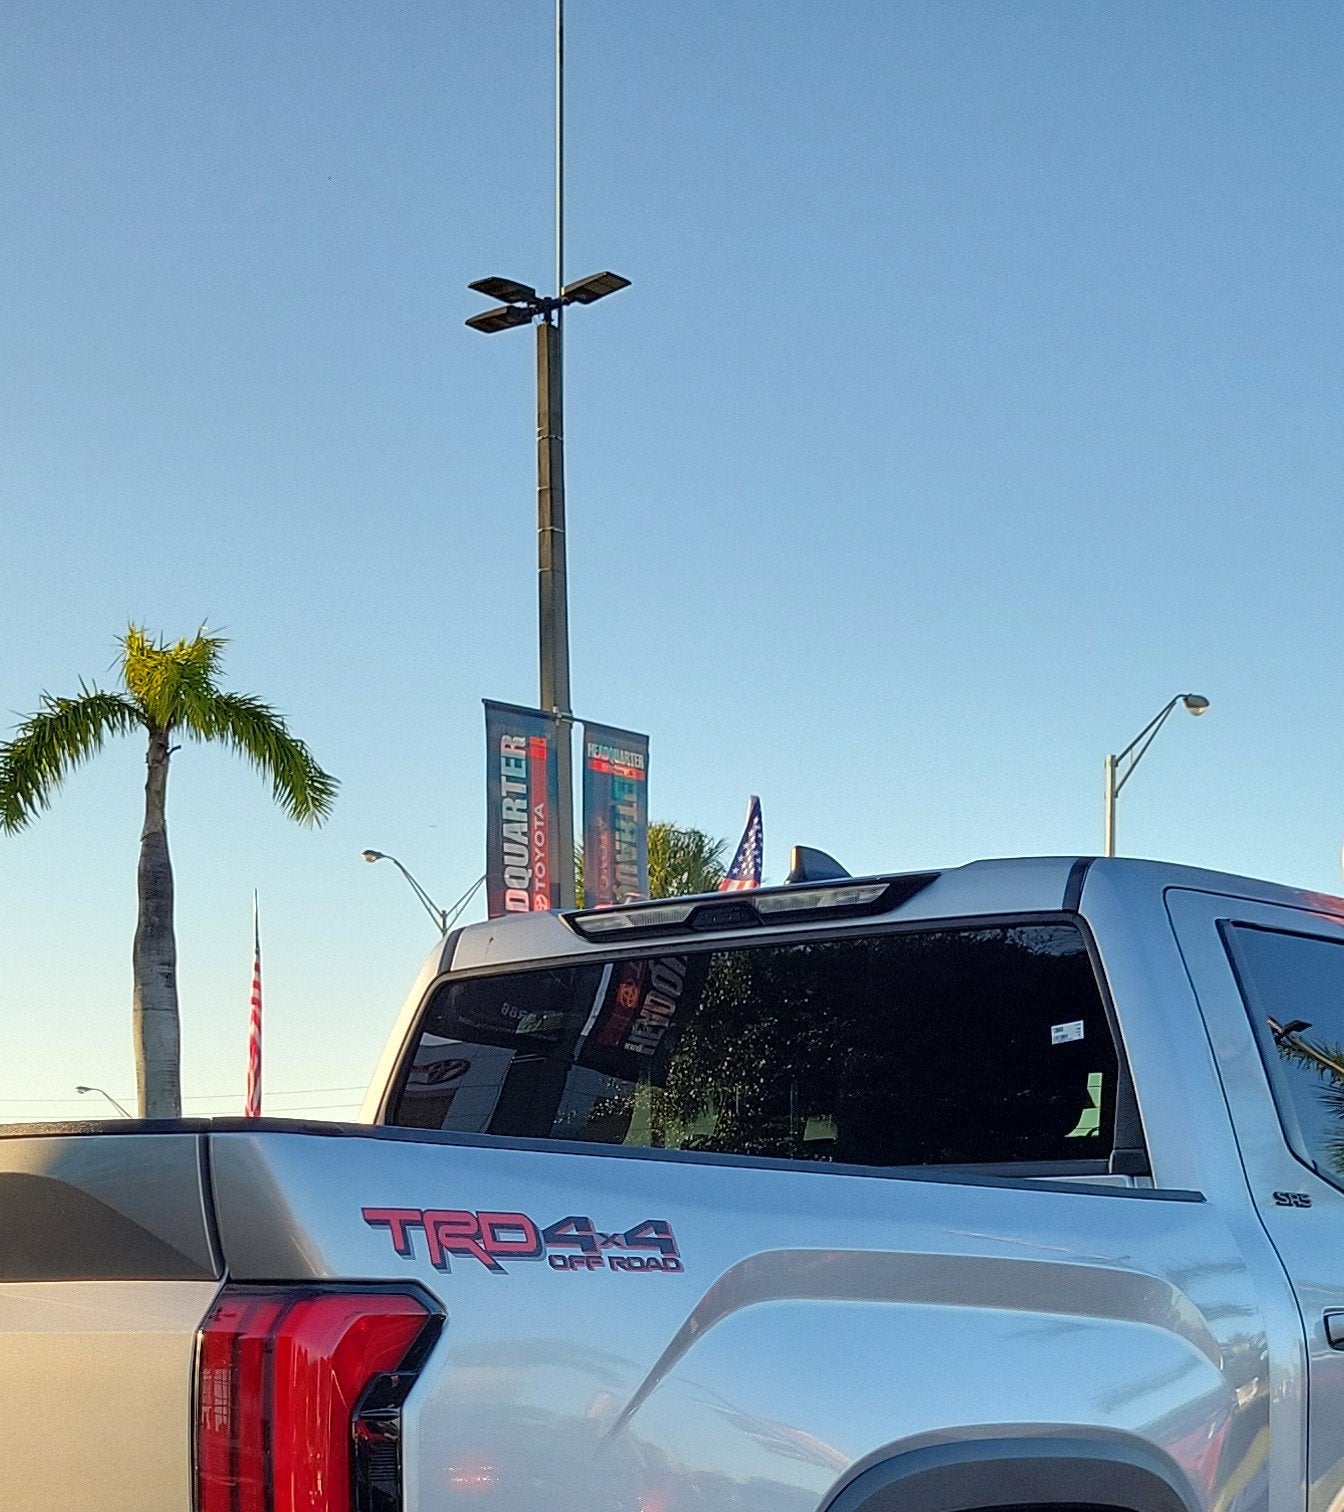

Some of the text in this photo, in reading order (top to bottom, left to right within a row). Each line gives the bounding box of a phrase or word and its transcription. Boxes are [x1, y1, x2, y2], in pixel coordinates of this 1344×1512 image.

[587, 742, 645, 769] HEADQUARTER
[534, 803, 546, 891] TOYOTA
[361, 1207, 547, 1275] TRD
[548, 1255, 684, 1273] OFF ROAD
